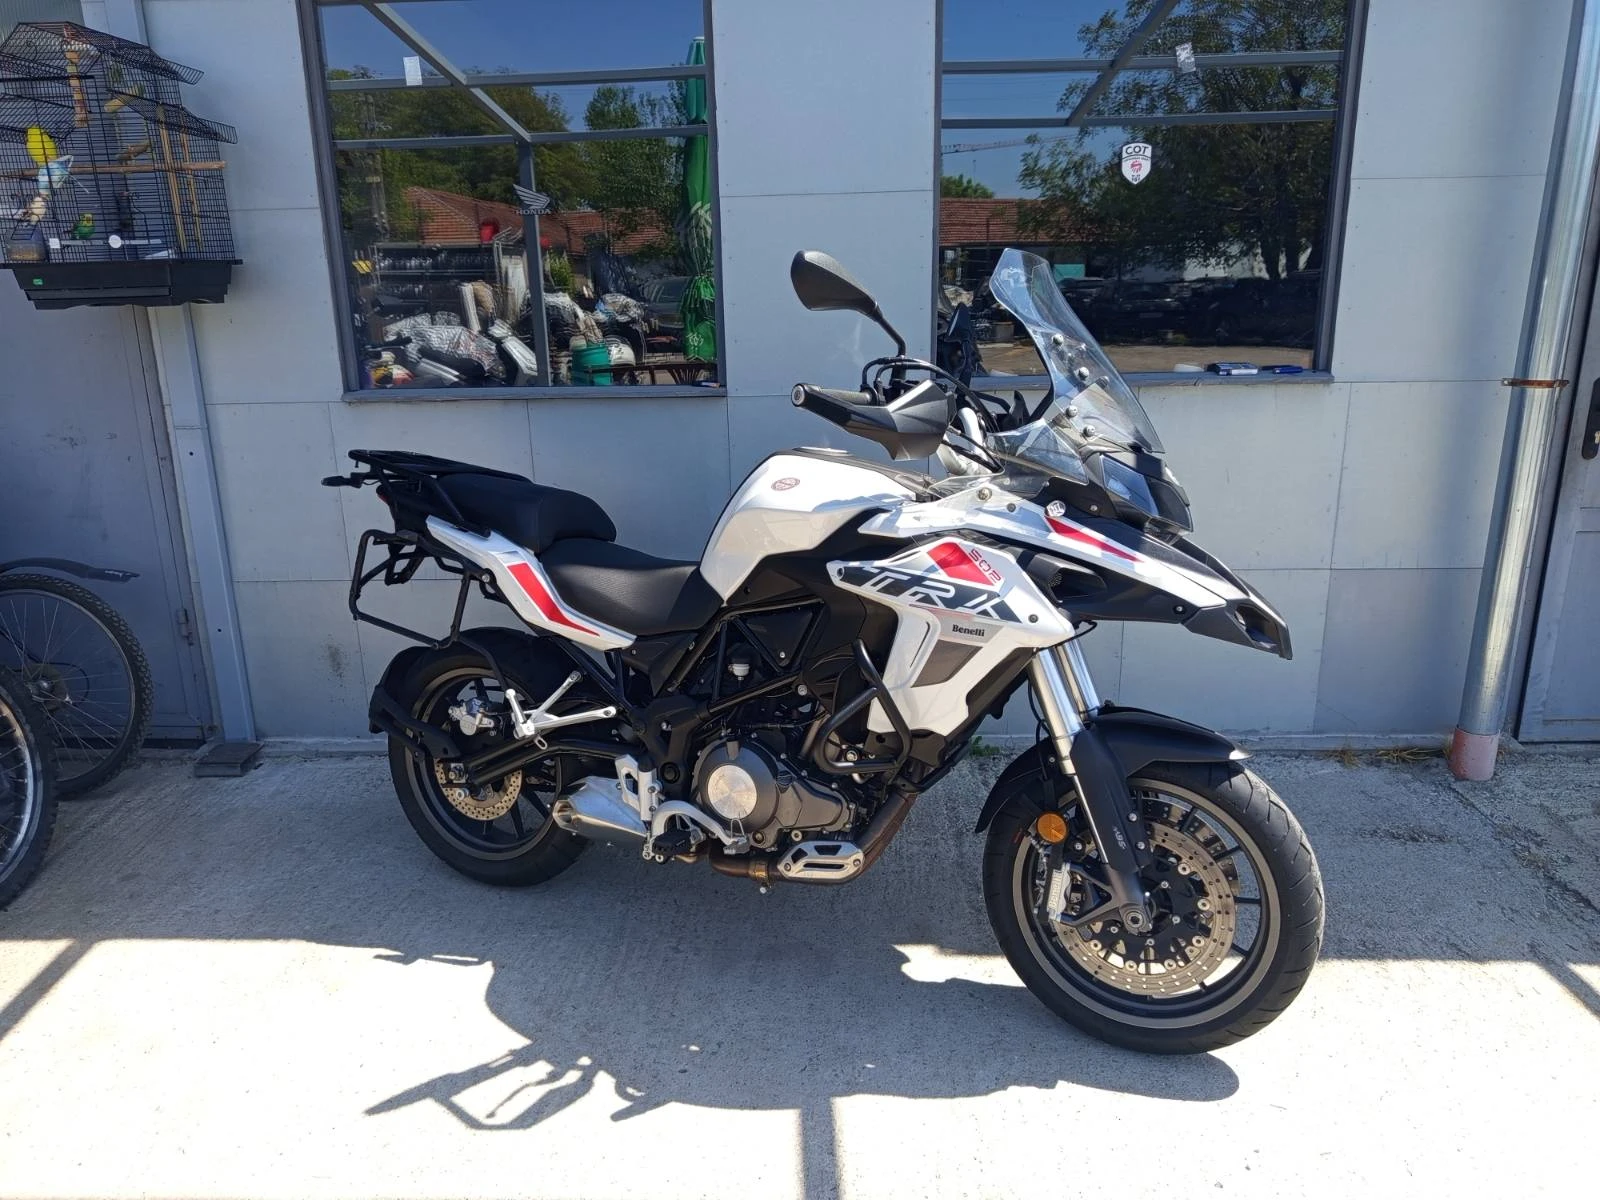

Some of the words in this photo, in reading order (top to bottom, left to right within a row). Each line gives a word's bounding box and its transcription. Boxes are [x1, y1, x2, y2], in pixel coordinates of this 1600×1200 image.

[969, 549, 1001, 583] 502
[861, 566, 1002, 620] TRK
[952, 624, 985, 637] Benelli
